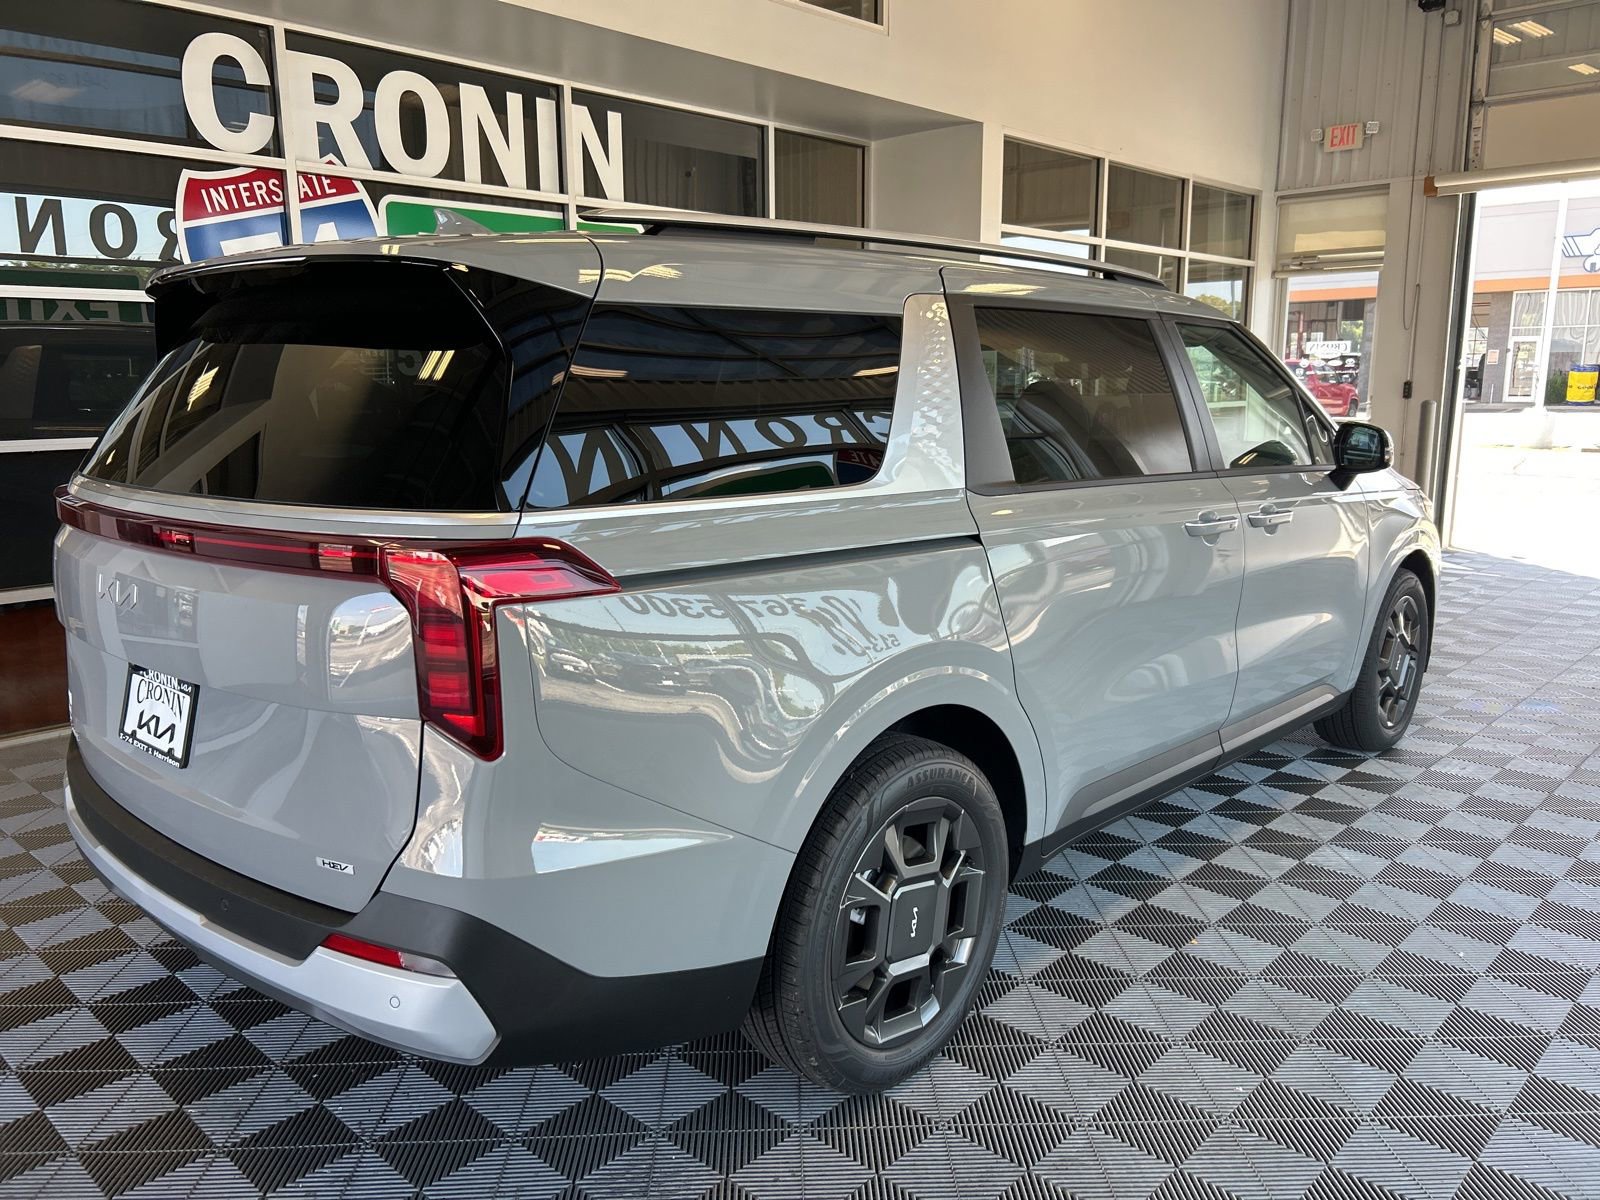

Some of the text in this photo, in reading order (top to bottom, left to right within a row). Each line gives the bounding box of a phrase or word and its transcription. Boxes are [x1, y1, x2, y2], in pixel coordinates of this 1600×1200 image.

[181, 32, 624, 202] CRONIN
[1330, 124, 1359, 148] EXIT
[201, 172, 337, 214] INTERSATE
[137, 678, 186, 723] CRONIN
[137, 709, 176, 744] KIA
[133, 739, 148, 752] EXIT
[153, 750, 180, 768] Harrison
[906, 767, 974, 790] ASSURANCE
[322, 859, 349, 871] HEV
